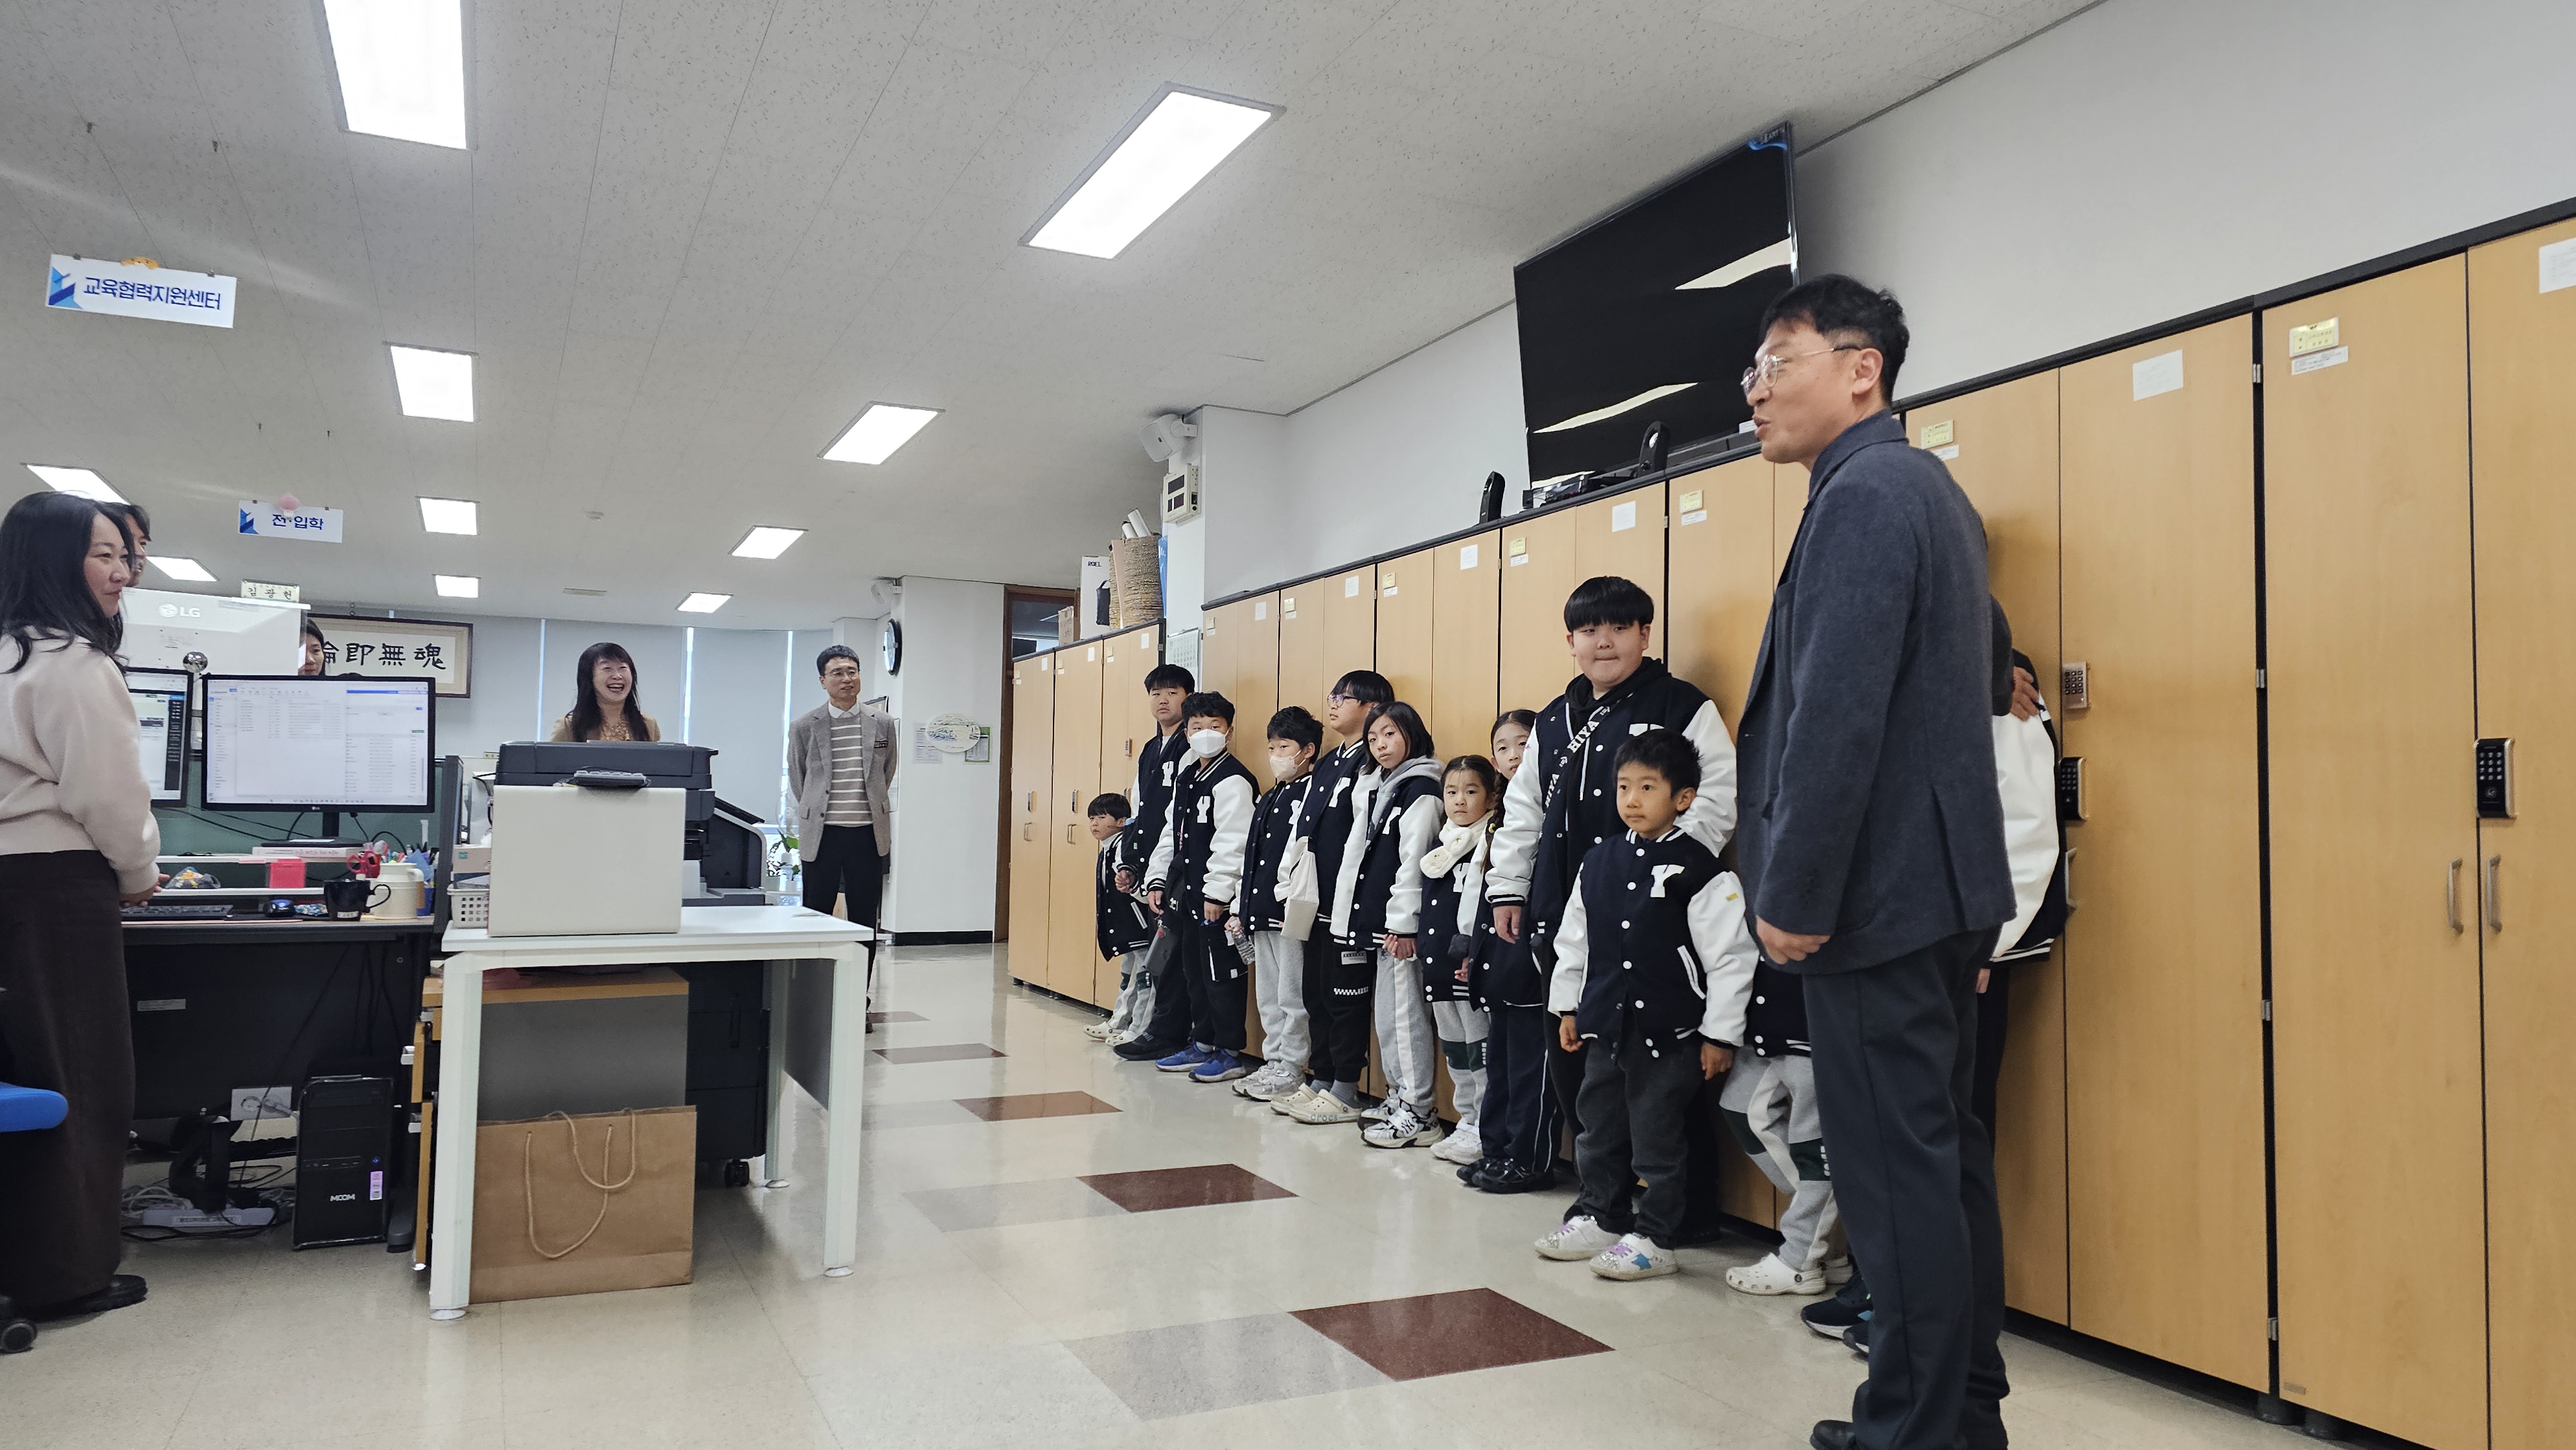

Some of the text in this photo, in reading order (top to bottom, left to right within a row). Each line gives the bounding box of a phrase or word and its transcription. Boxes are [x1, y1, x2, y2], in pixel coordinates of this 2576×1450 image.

[83, 276, 221, 310] 교육협력지원센터
[272, 513, 324, 530] 전·입학
[180, 606, 201, 617] LG
[1162, 761, 1174, 787] Y
[1197, 796, 1211, 823] Y
[1650, 864, 1685, 898] Y
[1311, 1113, 1338, 1122] crocs
[330, 1193, 355, 1201] MCOM
